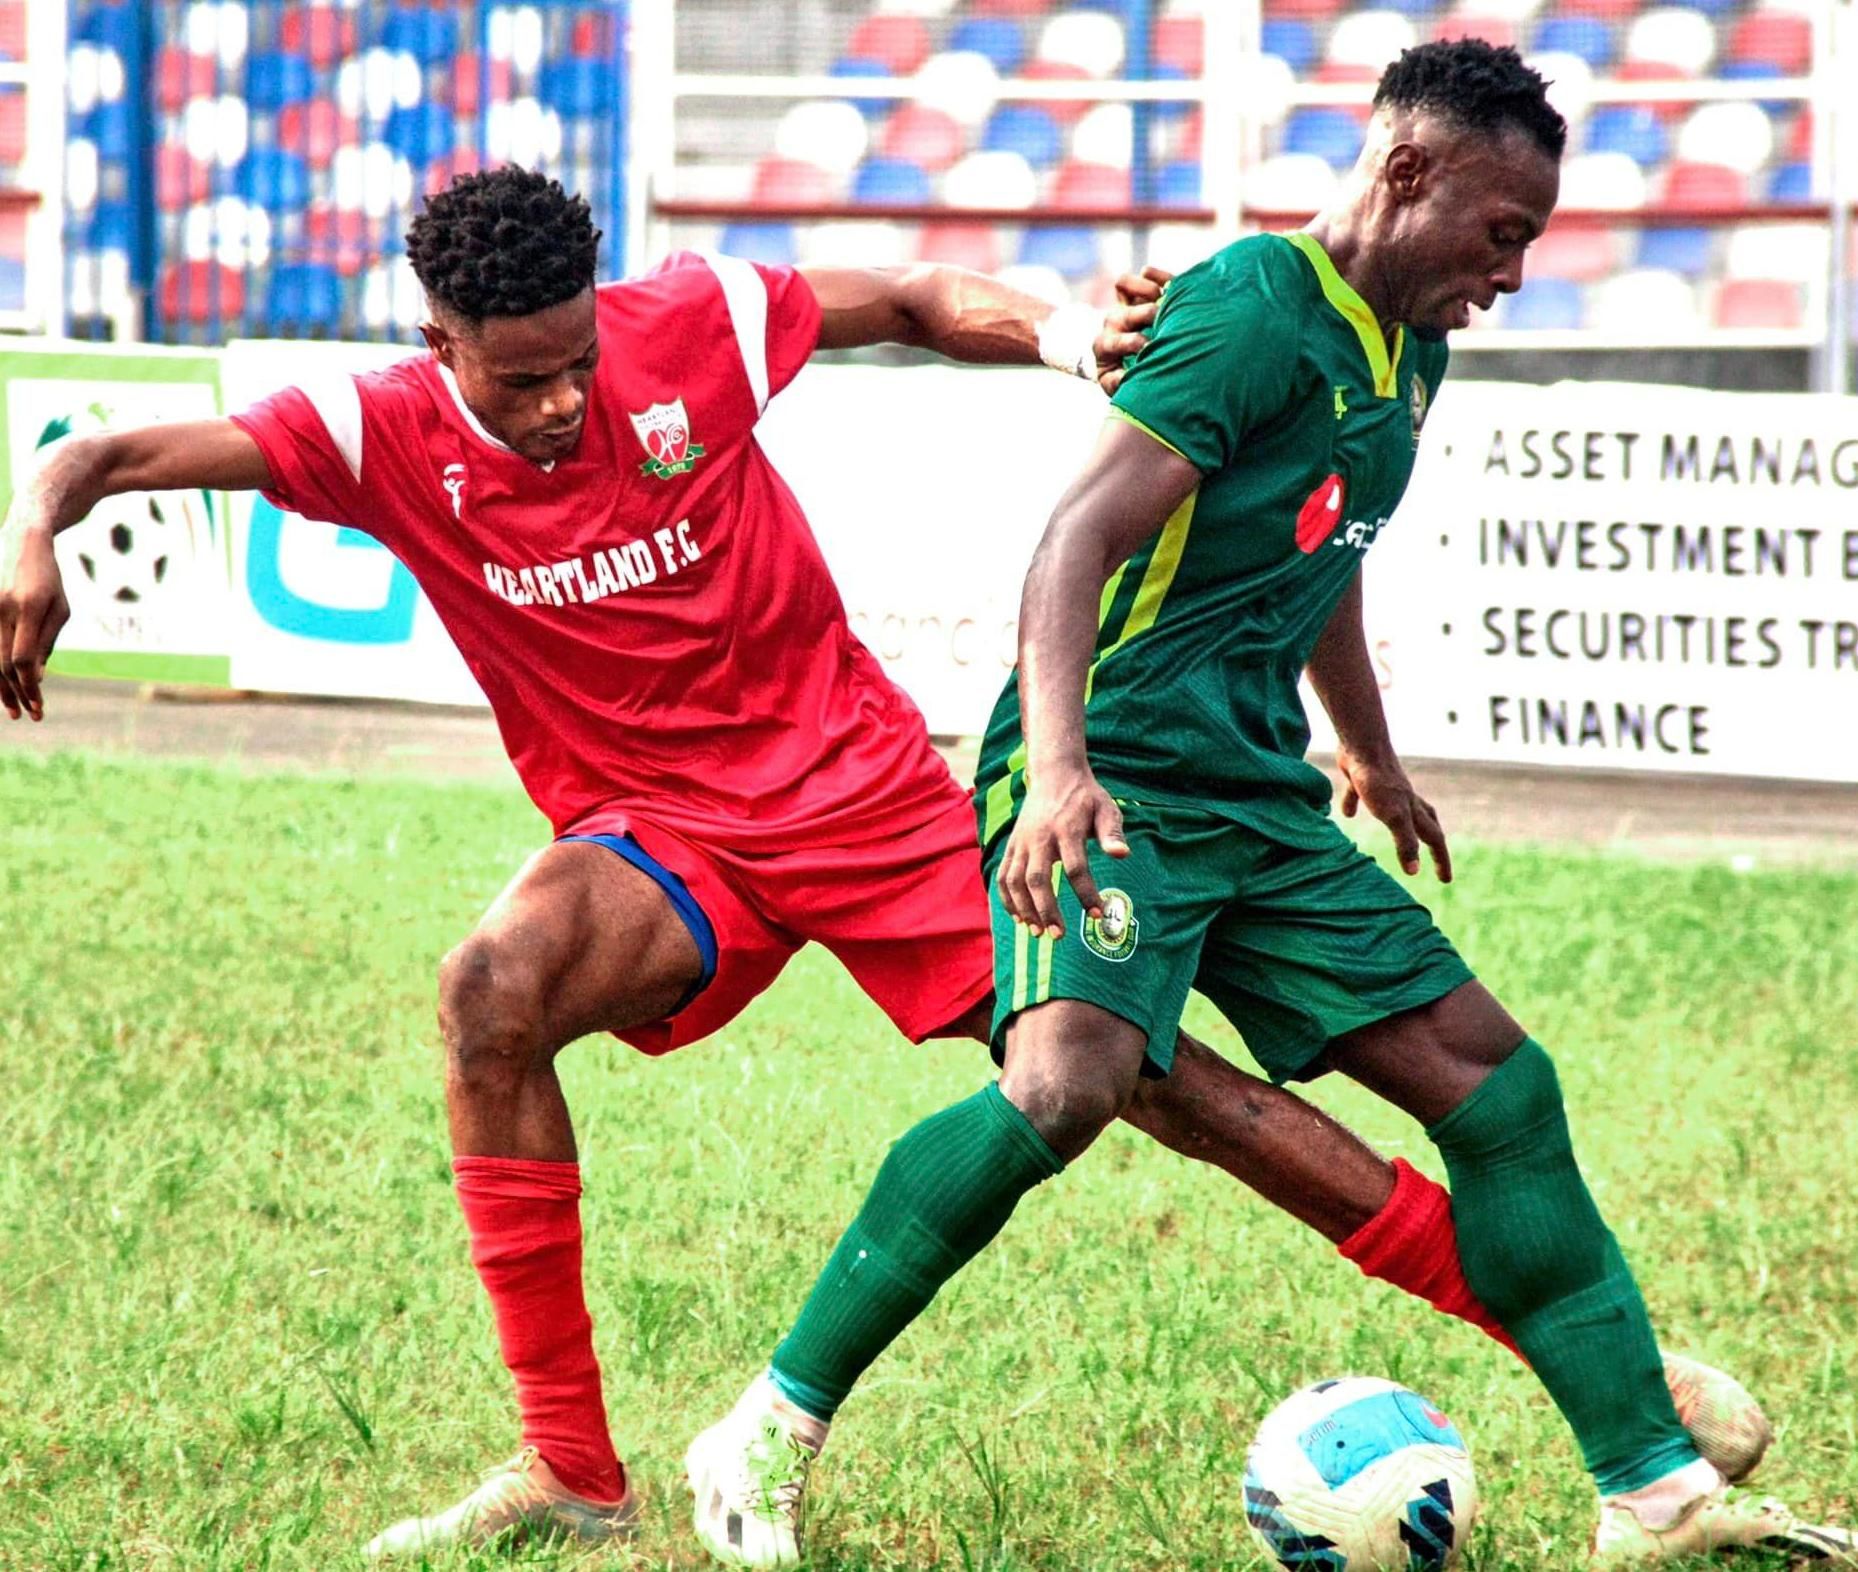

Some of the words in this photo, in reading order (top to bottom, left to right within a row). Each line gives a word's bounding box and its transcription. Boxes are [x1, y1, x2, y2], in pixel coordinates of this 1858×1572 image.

[1484, 429, 1640, 481] ASSET
[482, 539, 657, 607] HEARTLAND
[653, 518, 702, 575] F.C
[1479, 518, 1822, 578] INVESTMENT
[1482, 606, 1782, 669] SECURITIES
[1488, 695, 1710, 756] FINANCE
